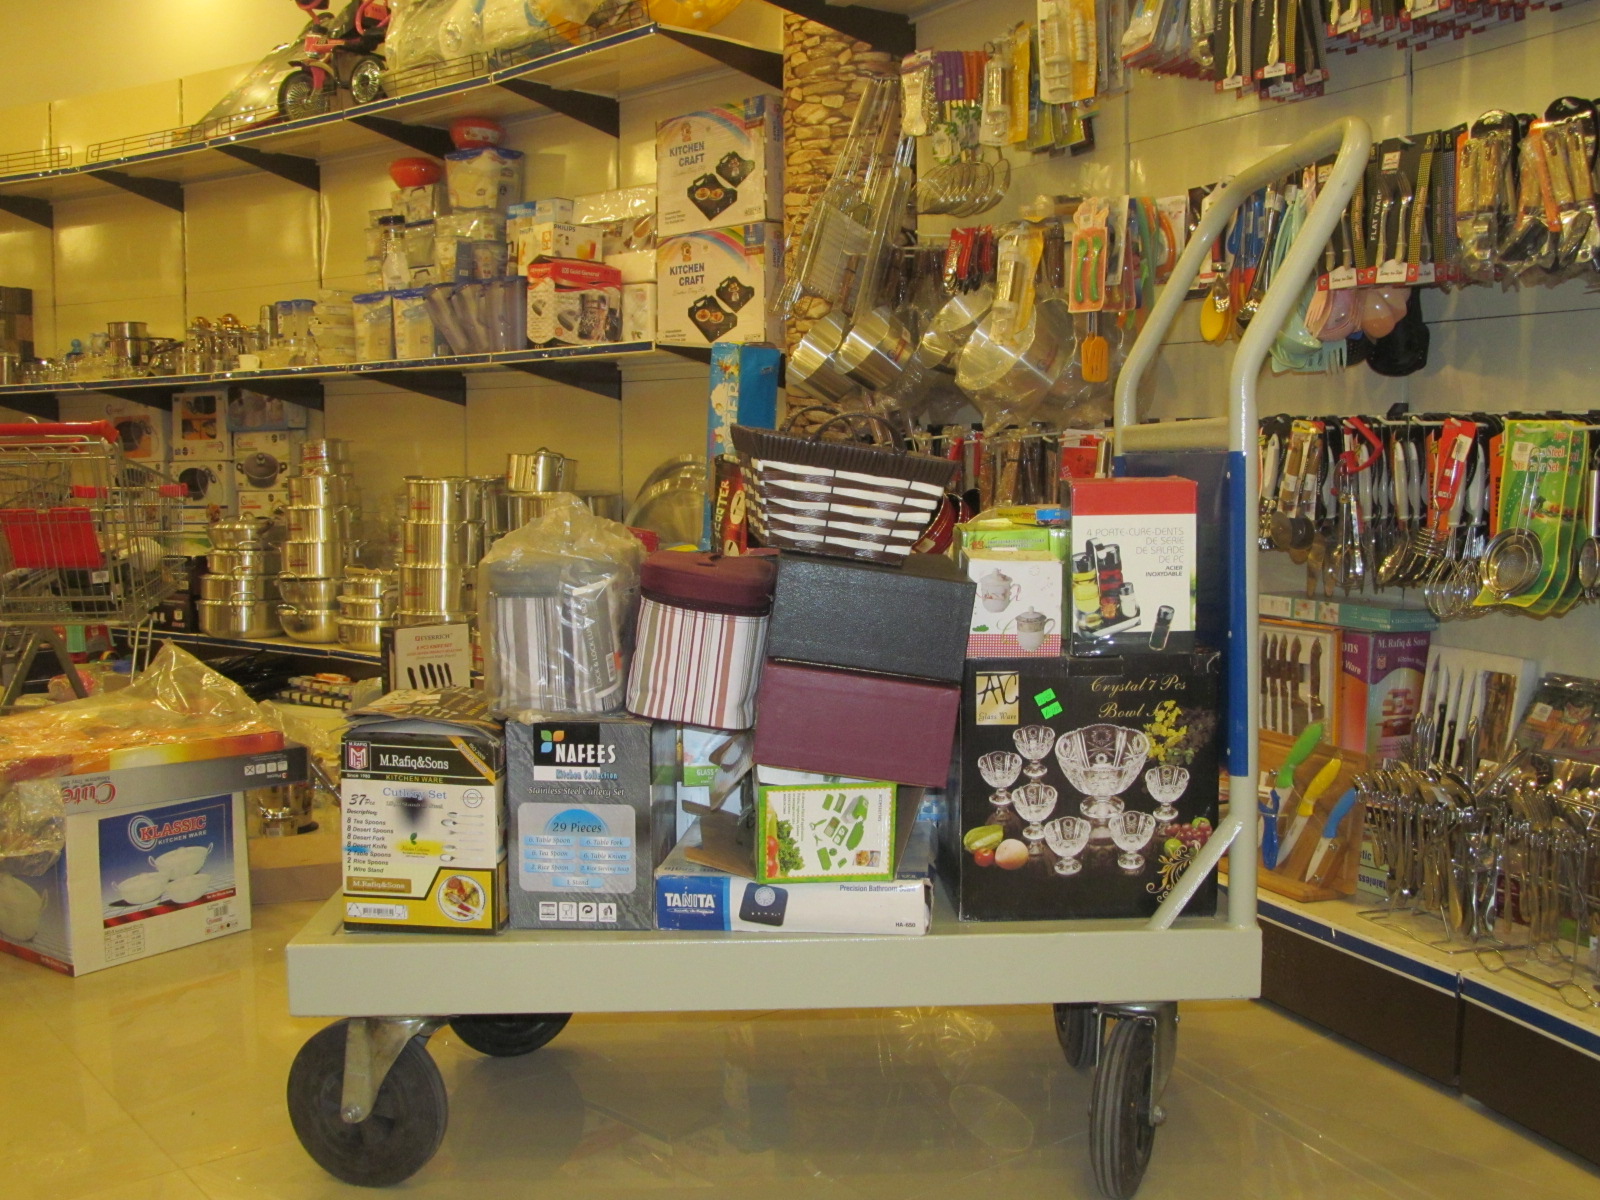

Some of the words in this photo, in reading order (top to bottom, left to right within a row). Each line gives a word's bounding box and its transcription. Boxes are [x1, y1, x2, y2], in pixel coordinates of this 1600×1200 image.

[669, 141, 705, 157] KITCHEN
[678, 153, 705, 167] CRAFT
[554, 224, 576, 232] PHILIPS
[1370, 218, 1378, 241] FLAT
[670, 262, 705, 276] KITCHEN
[678, 274, 705, 286] CRAFT
[714, 480, 730, 539] SCOOTER
[1146, 537, 1158, 545] DE
[1150, 546, 1184, 554] SALADE
[1173, 555, 1184, 563] PC
[589, 640, 598, 660] LOCK
[1346, 660, 1361, 674] Ware
[1091, 676, 1148, 698] Crystal
[1148, 680, 1157, 691] 7
[1160, 674, 1186, 691] Pcs
[978, 712, 996, 721] Glass
[1000, 712, 1016, 720] Ware
[1098, 702, 1145, 718] Bowl
[555, 744, 616, 764] NAFEES
[379, 754, 449, 770] M.Rafiq&Sons
[556, 769, 581, 780] Kitchen
[583, 770, 618, 780] Collection
[62, 781, 117, 805] Cute
[383, 787, 424, 800] Cutlery
[428, 790, 447, 800] Set
[528, 786, 561, 795] Stainless
[563, 787, 581, 795] Steel
[583, 787, 611, 799] Cutlery
[140, 815, 207, 841] KLASSIC
[552, 822, 567, 832] 29
[571, 822, 602, 833] Pieces
[158, 835, 187, 844] KITCHEN
[189, 830, 207, 838] WARE
[664, 892, 715, 908] TANITA
